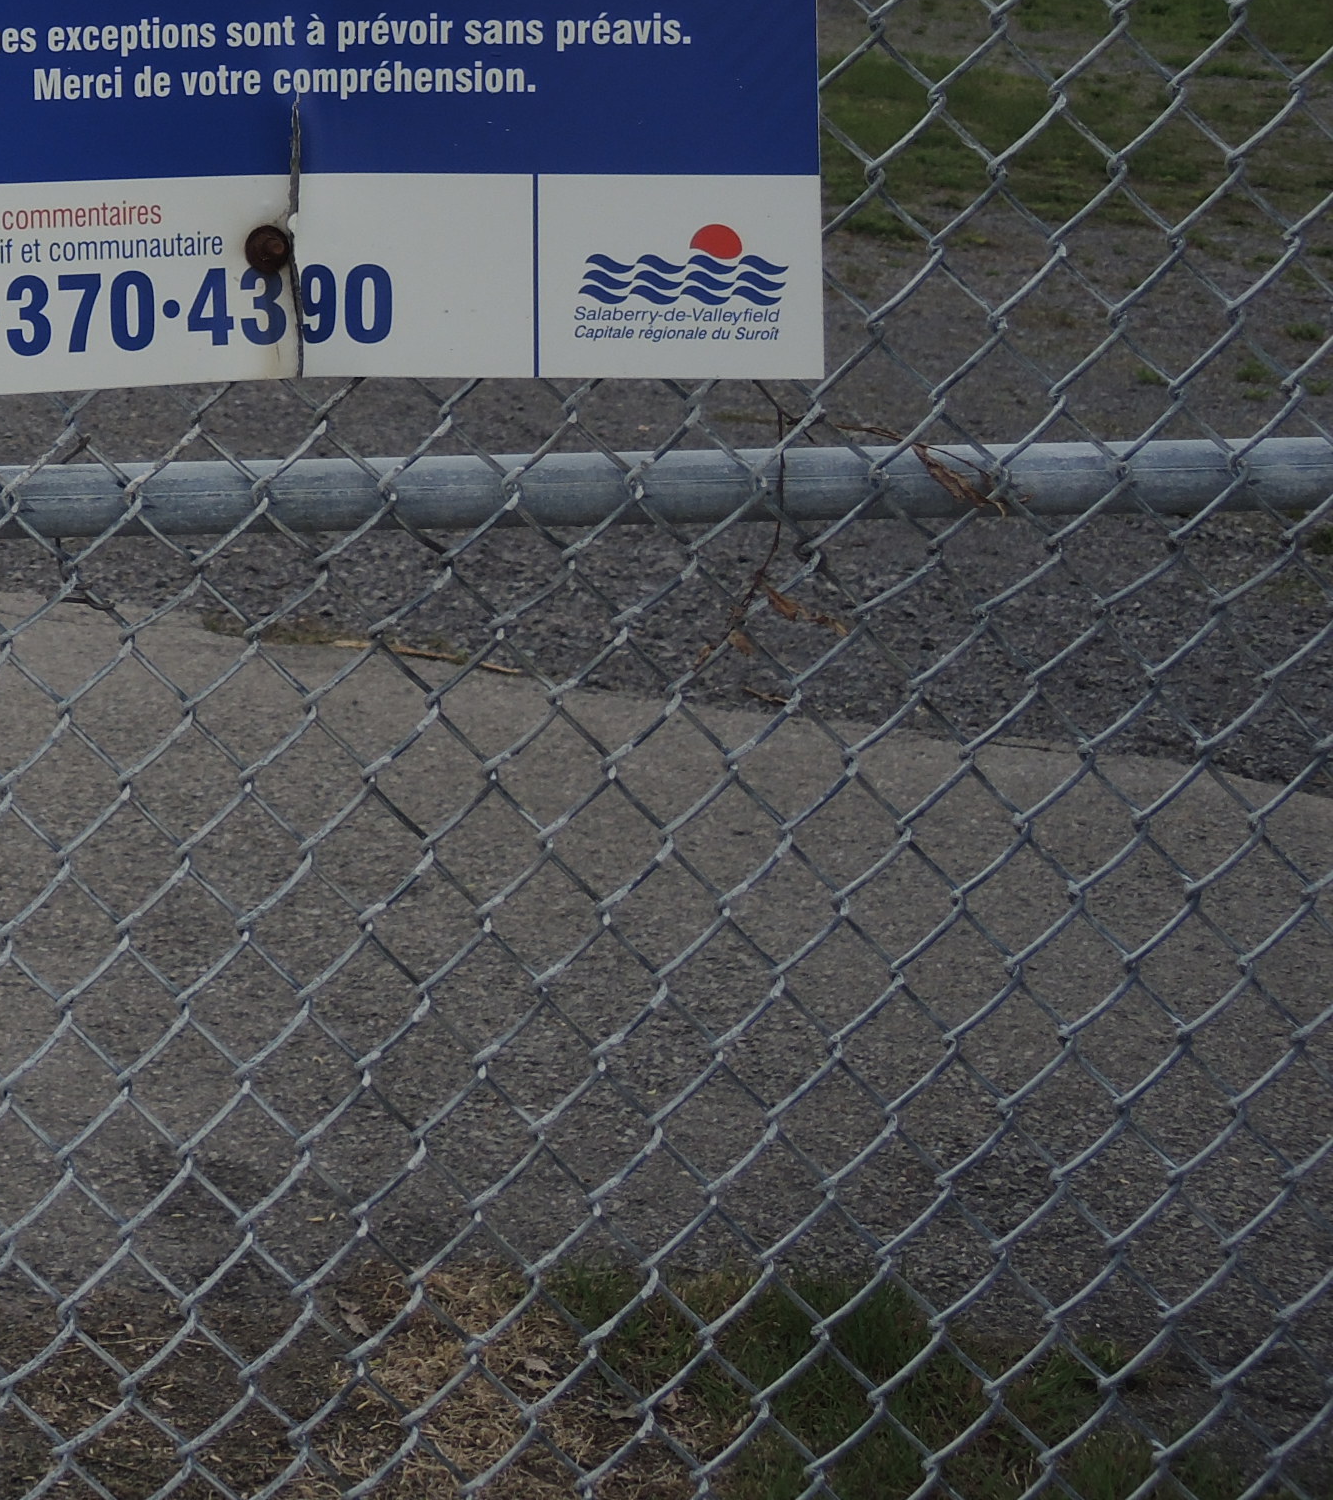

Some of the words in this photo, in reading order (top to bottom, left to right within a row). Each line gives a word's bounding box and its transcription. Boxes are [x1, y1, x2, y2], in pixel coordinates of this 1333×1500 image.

[47, 16, 216, 57] exceptions
[226, 15, 296, 48] sont
[306, 13, 325, 46] à
[337, 12, 453, 53] prévoir
[464, 19, 544, 46] sans
[556, 12, 692, 52] préavis.
[33, 66, 122, 101] Merci
[134, 65, 171, 99] de
[181, 64, 261, 97] votre
[272, 60, 537, 103] compréhension.
[2, 202, 162, 231] commentaires
[21, 241, 42, 263] et
[49, 231, 223, 261] communautaire
[573, 306, 781, 326] Salaberry-de-Valleyfield
[574, 324, 635, 342] Capitale
[638, 325, 708, 343] régionale
[711, 326, 731, 340] du
[734, 326, 780, 341] Suroît
